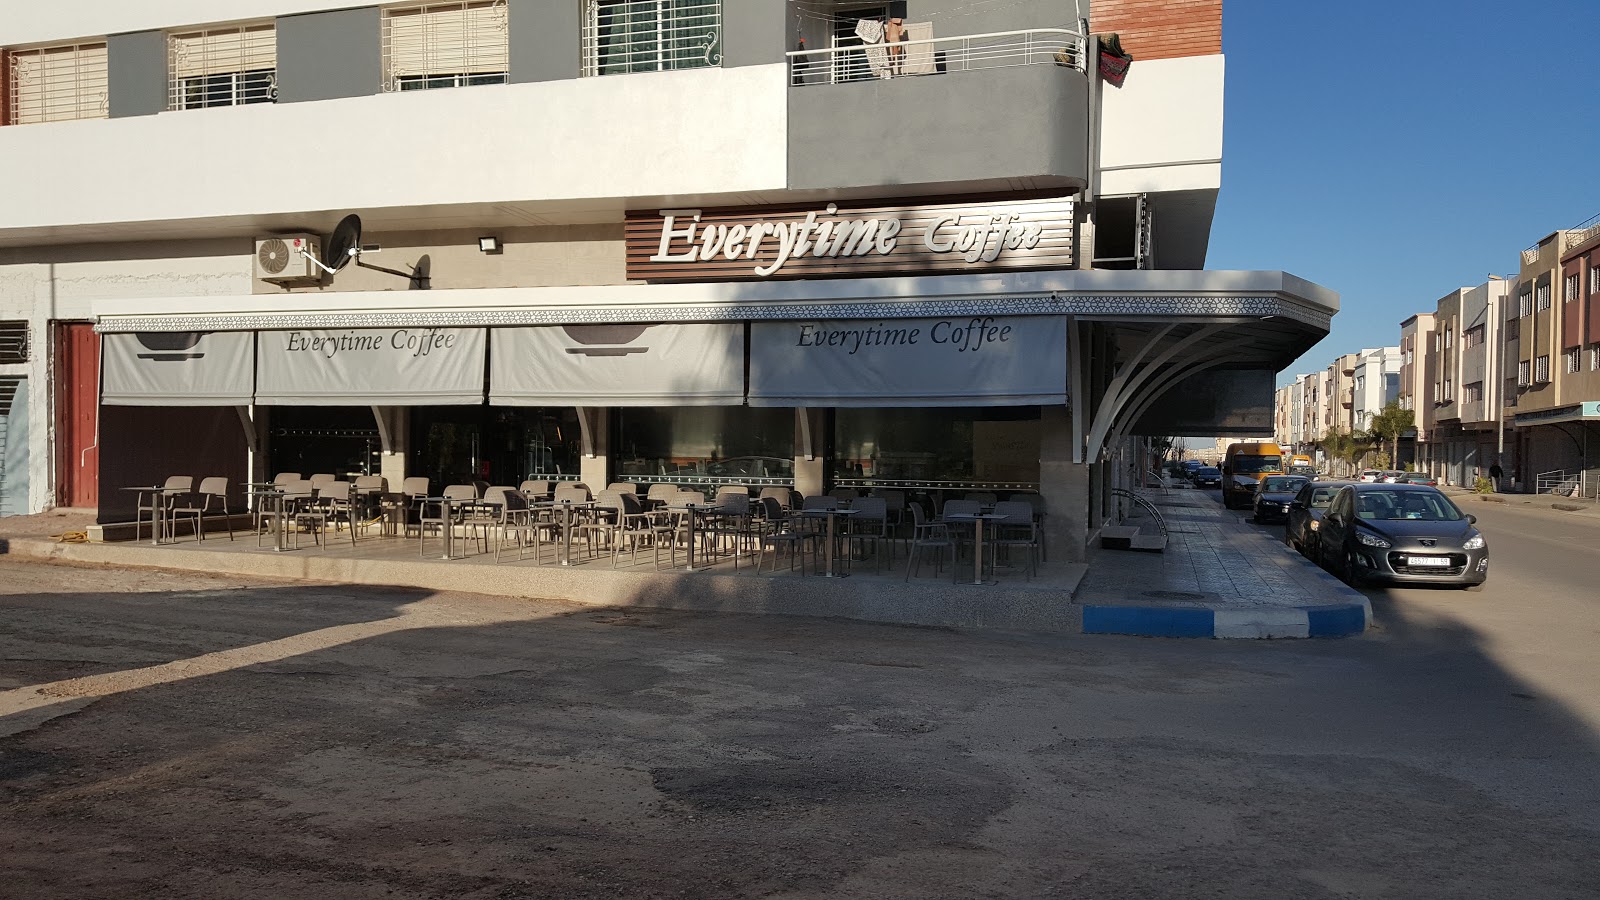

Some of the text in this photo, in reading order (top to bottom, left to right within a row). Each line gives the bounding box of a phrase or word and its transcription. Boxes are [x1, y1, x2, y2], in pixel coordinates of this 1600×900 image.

[649, 203, 1043, 277] Everytime Coffee
[286, 327, 456, 359] Everytime Coffee
[796, 317, 1012, 355] Everytime Coffee
